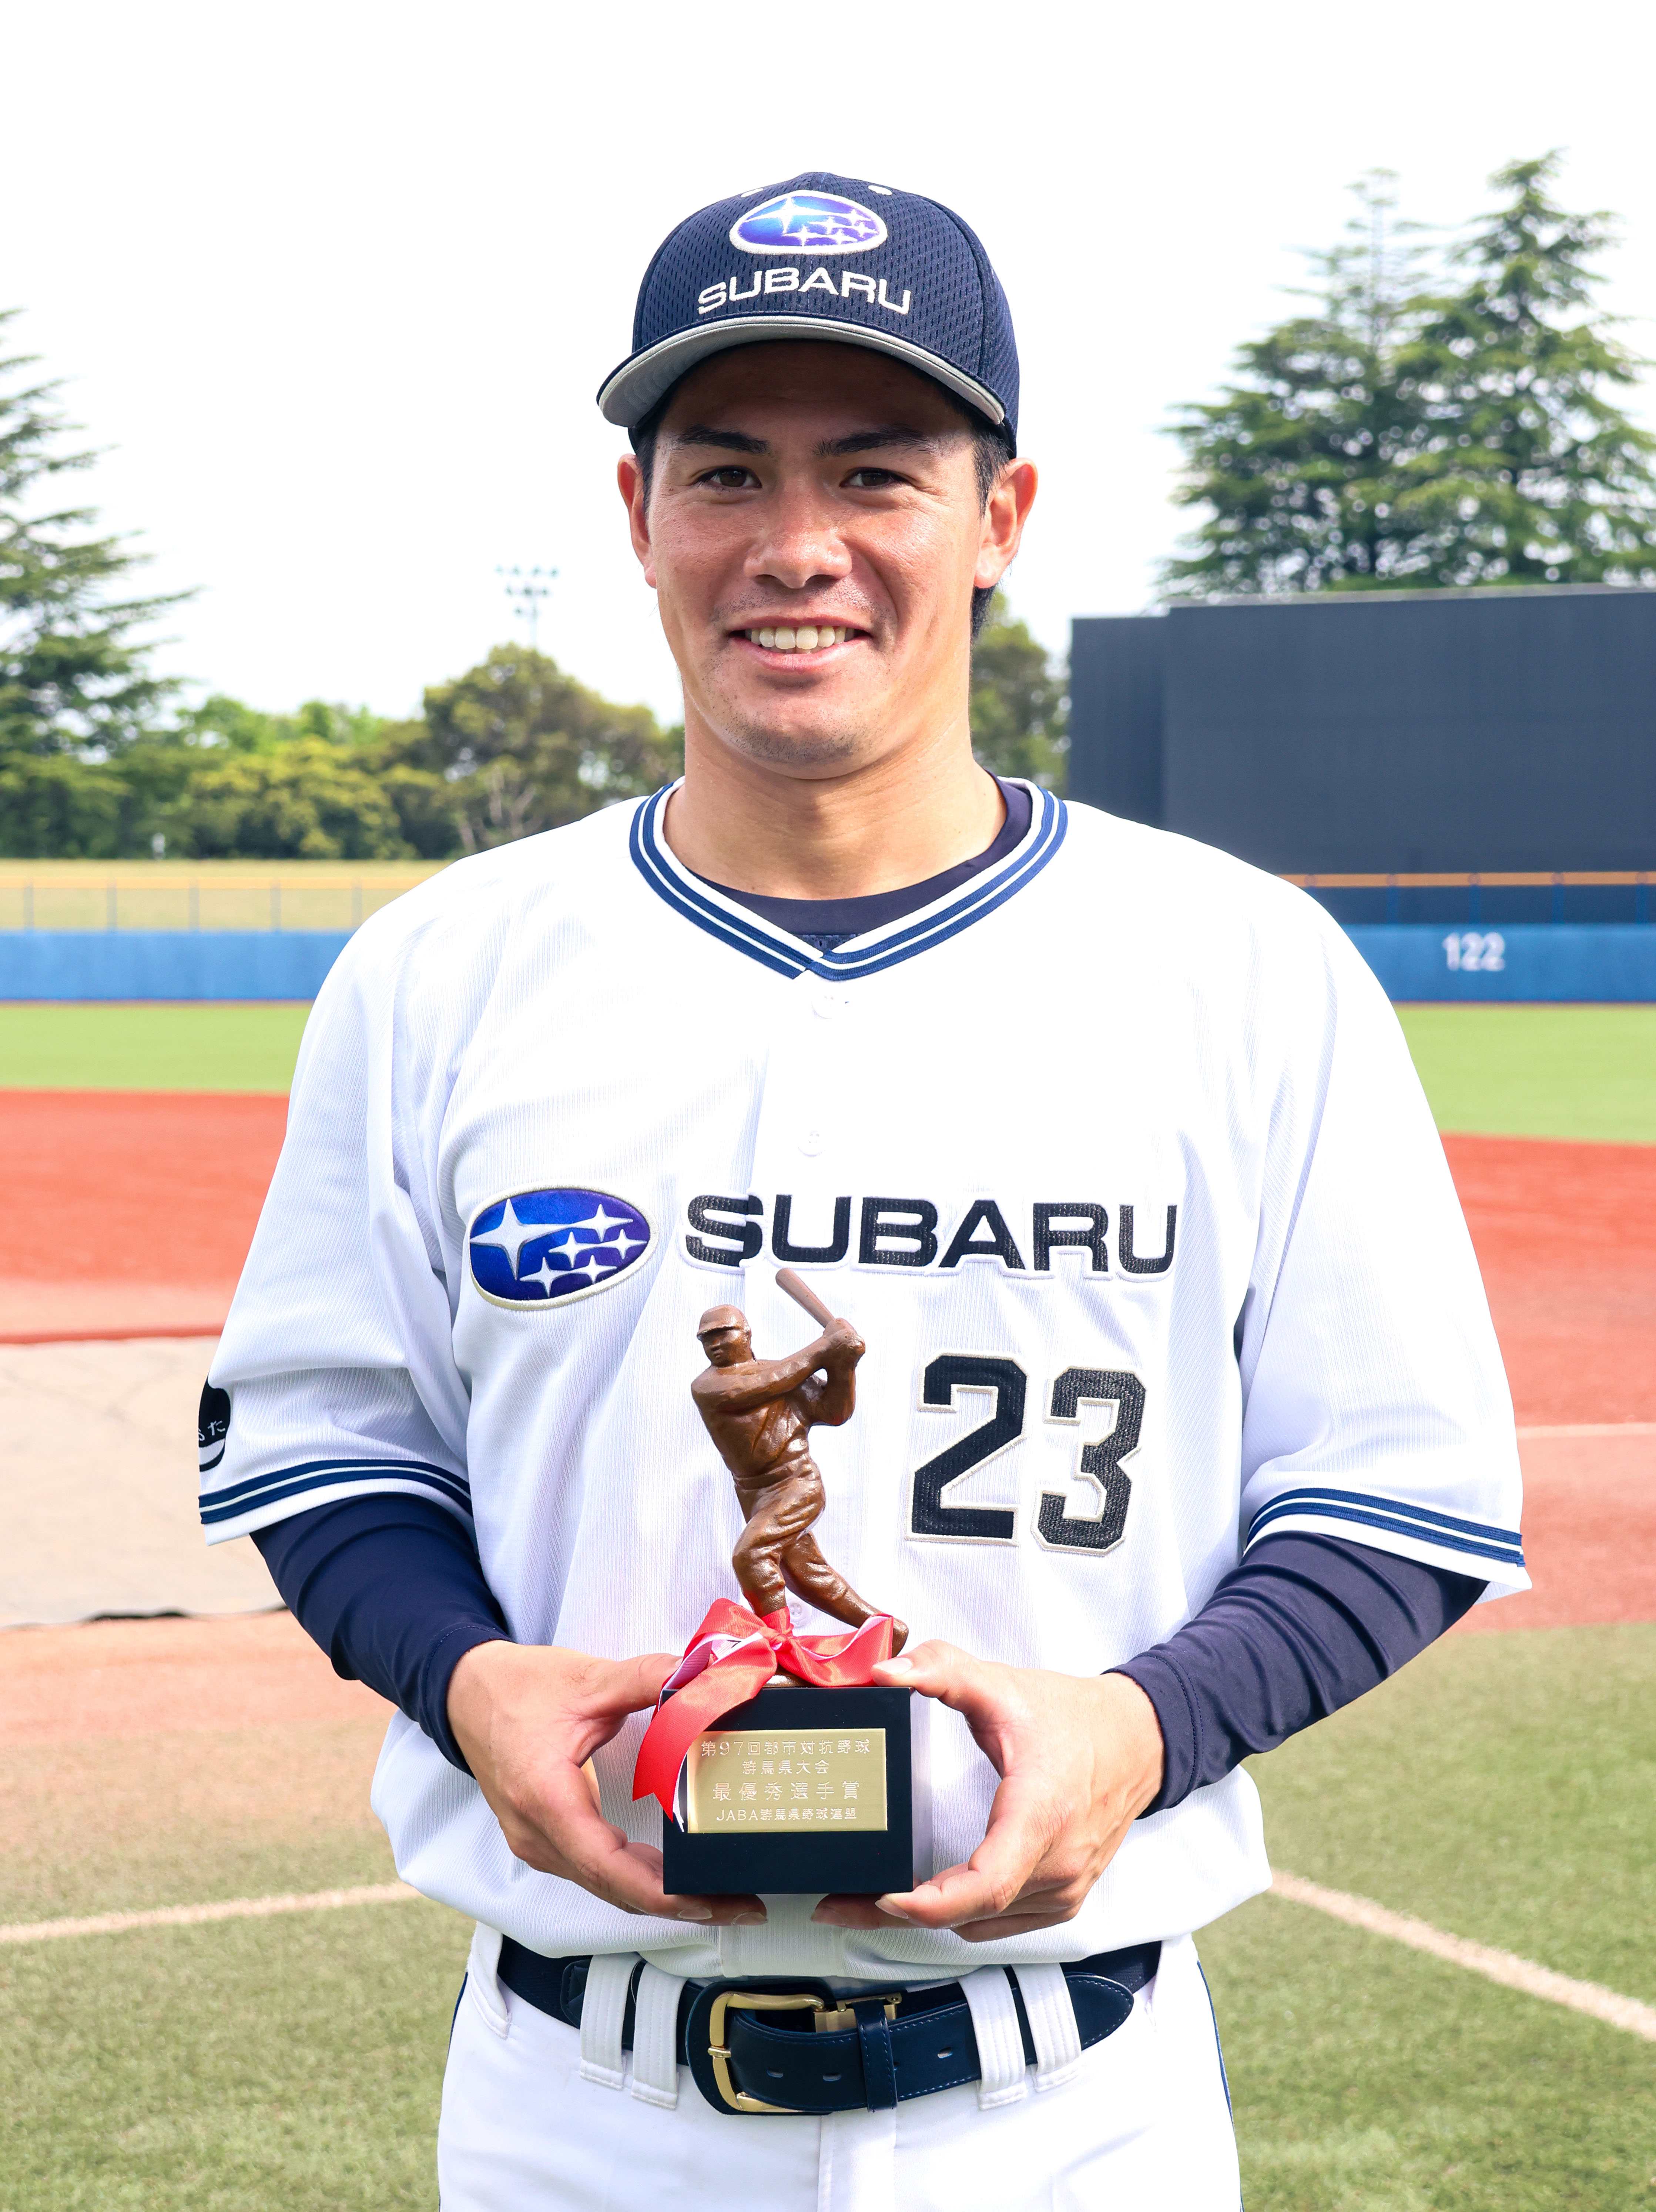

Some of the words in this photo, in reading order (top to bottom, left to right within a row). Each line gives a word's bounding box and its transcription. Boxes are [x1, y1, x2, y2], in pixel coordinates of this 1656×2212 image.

[697, 267, 912, 315] SUBARU
[1442, 931, 1505, 971] 122
[685, 1194, 1177, 1274] SUBARU
[905, 1353, 1147, 1556] 23
[701, 1739, 870, 1756] 第97回都市対抗野球
[742, 1759, 829, 1775] 群馬県大会
[713, 1780, 859, 1801] 最優秀選手賞
[716, 1807, 857, 1821] JABA群馬県野球連盟
